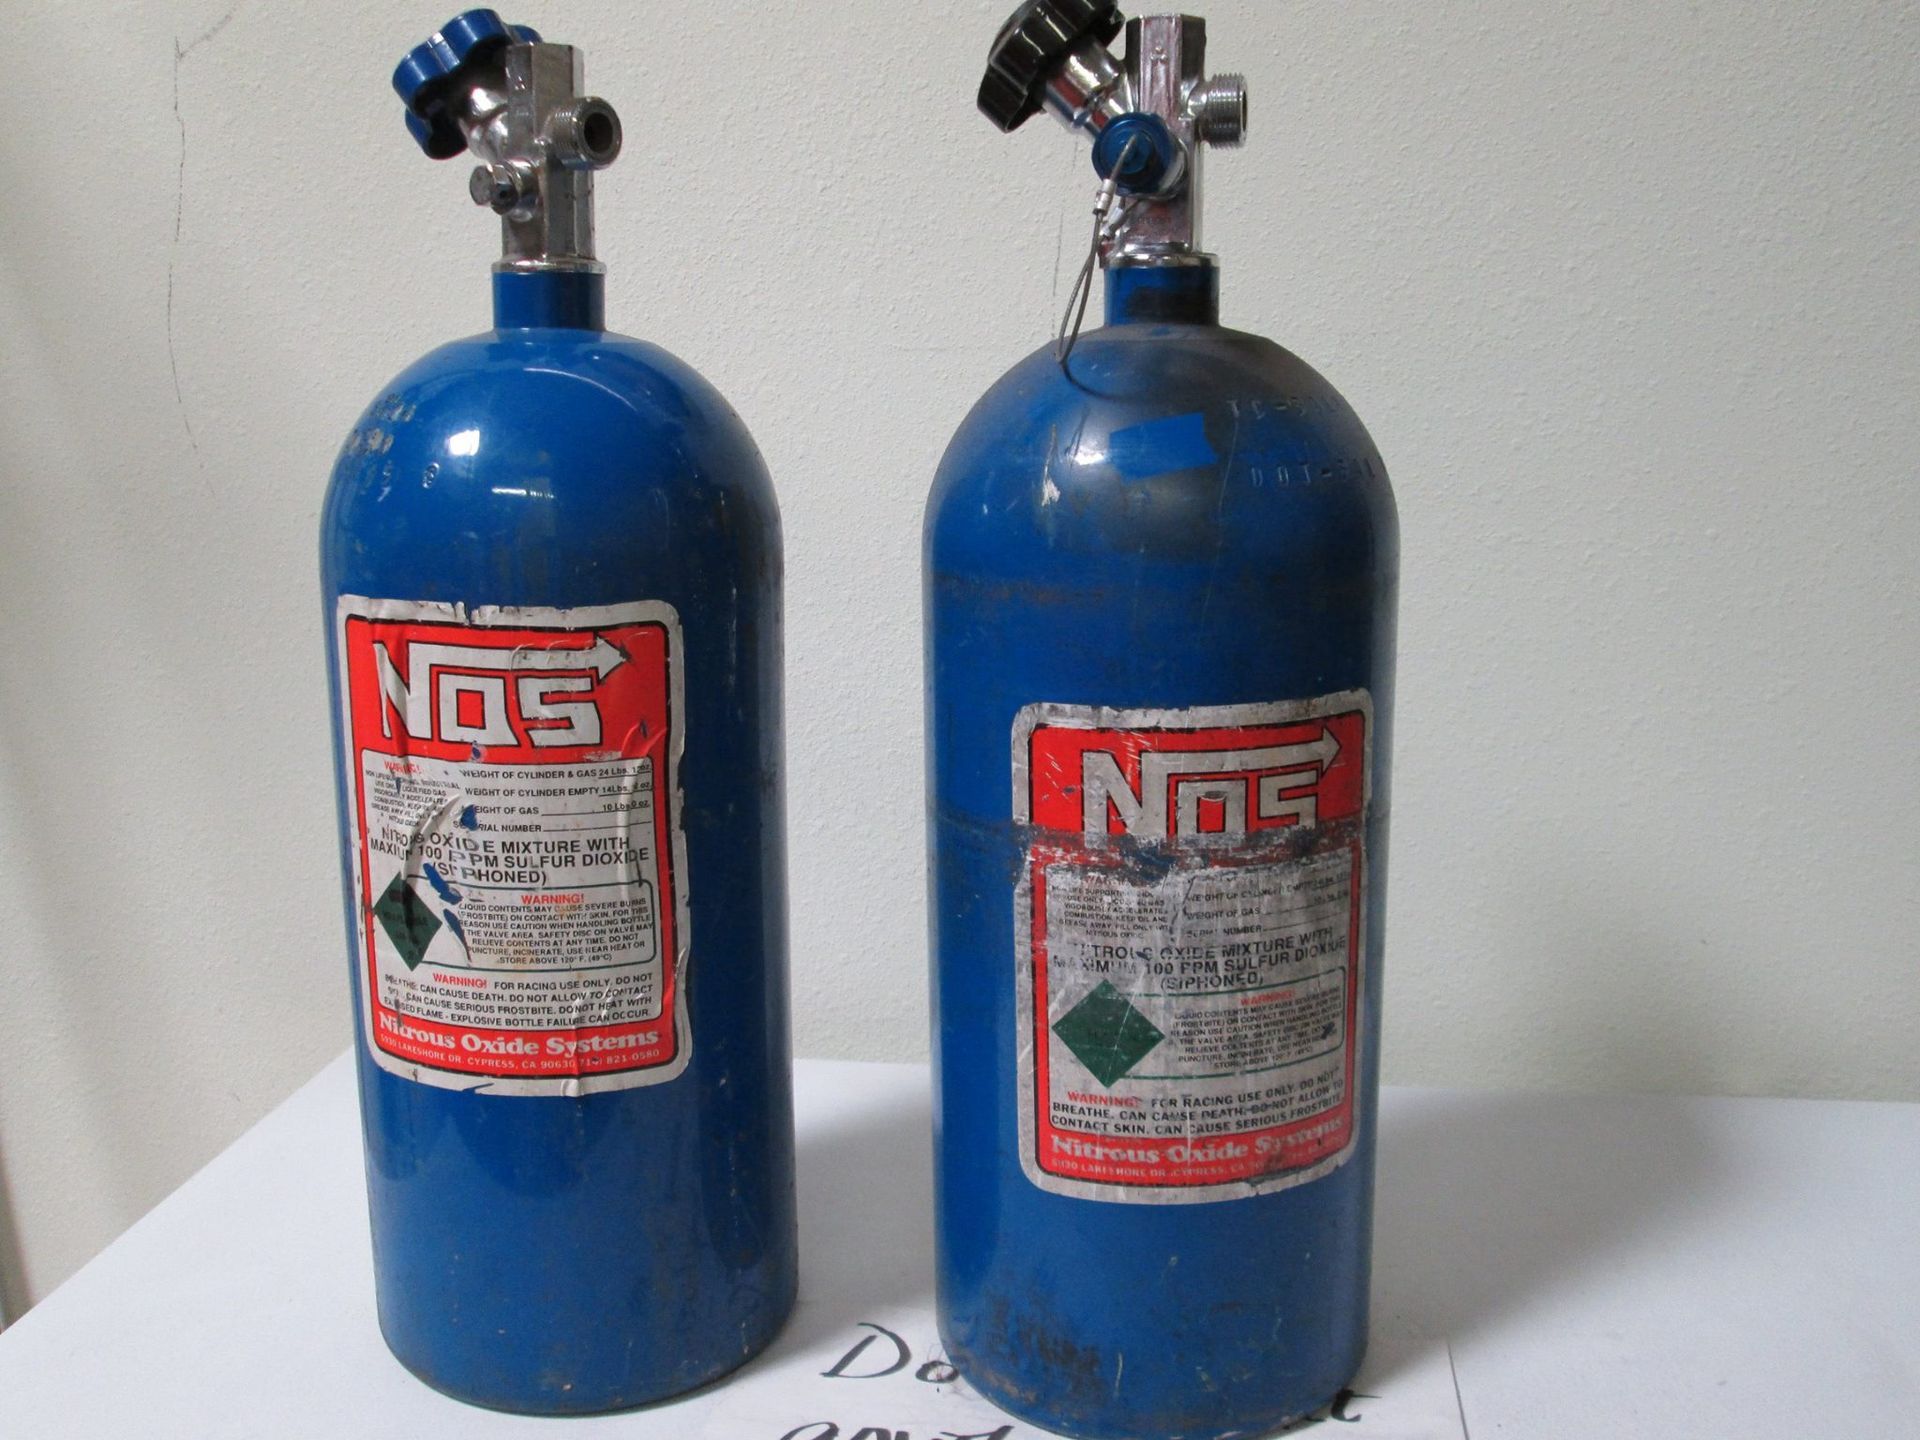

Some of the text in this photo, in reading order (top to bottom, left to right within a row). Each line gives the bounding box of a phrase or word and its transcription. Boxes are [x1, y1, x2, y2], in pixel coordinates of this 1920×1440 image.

[373, 637, 606, 748] NOS
[460, 770, 500, 779] WEIGHT
[502, 771, 515, 779] OF
[517, 770, 565, 779] CYLINDER
[567, 770, 574, 778] &
[576, 769, 597, 778] GAS
[599, 768, 609, 776] 24
[465, 786, 600, 797] WEIGHT OF CYLINDER EMPTY
[1083, 744, 1322, 850] NOS
[504, 803, 613, 815] OF GAS 10
[453, 821, 542, 833] SRIAL NUMBER
[430, 832, 496, 853] OXIDE
[502, 839, 581, 854] MIXTURE
[587, 837, 630, 850] WITH
[419, 846, 443, 860] 100
[504, 852, 576, 869] SULFUR
[582, 847, 650, 867] DIOXIDE
[459, 903, 487, 912] LIQUID
[488, 905, 532, 913] CONTENTS
[534, 905, 552, 913] MAY
[585, 901, 618, 911] SEVERE
[521, 893, 585, 905] WARNING!
[524, 913, 564, 921] CONTACT
[566, 912, 588, 920] WITH
[612, 909, 629, 917] FOR
[631, 906, 649, 915] THIS
[1241, 907, 1262, 917] GAS
[467, 922, 653, 939] THE VALVE SAFETY DISC ON VALVE MAY
[492, 922, 510, 930] USE
[510, 922, 548, 930] CAUTION
[549, 921, 575, 930] WHEN
[576, 919, 619, 929] HANDLING
[620, 914, 651, 925] BOTTLE
[1222, 924, 1263, 936] NUMBER
[472, 933, 639, 947] RELIEVE CONTENTS AT ANY DO NOT
[566, 940, 646, 954] USE NEAR HEAT OR
[1221, 936, 1295, 958] MIXTURE
[1299, 926, 1333, 946] WITH
[499, 956, 559, 965] STORE ABOVE
[1145, 962, 1174, 975] 100
[1224, 951, 1290, 972] SULFUR
[432, 972, 488, 989] WARNING!
[494, 981, 515, 990] FOR
[517, 982, 557, 991] RACING
[559, 980, 580, 990] USE
[615, 976, 631, 986] DO
[633, 972, 653, 983] NOT
[420, 983, 438, 994] CAN
[439, 987, 470, 1000] CAUSE
[509, 994, 524, 1003] DO
[527, 994, 548, 1003] NOT
[550, 991, 587, 1002] ALLOW
[589, 991, 603, 1000] TO
[605, 984, 653, 999] CONTACT
[405, 992, 422, 1005] CAN
[423, 995, 453, 1008] CAUSE
[454, 1000, 496, 1014] SERIOUS
[558, 1005, 574, 1014] DO
[575, 1002, 598, 1013] NOT
[598, 999, 623, 1011] HEAT
[626, 996, 652, 1007] WITH
[416, 1007, 444, 1020] FLAME
[450, 1013, 501, 1026] EXPLOSIVE
[505, 1017, 544, 1028] BOTTLE
[546, 1014, 587, 1027] FAILURE
[588, 1012, 610, 1024] CAN
[378, 1010, 660, 1059] Nitrous Oxide Systems
[398, 1041, 447, 1060] LAKESHORE
[521, 1059, 537, 1069] CA
[540, 1058, 576, 1070] 90630
[1151, 1097, 1178, 1108] FOR
[1182, 1094, 1234, 1108] RACING
[1237, 1090, 1262, 1104] USE
[1299, 1078, 1314, 1089] DO
[1119, 1110, 1147, 1121] CAN
[1151, 1111, 1196, 1121] CAUSE
[1270, 1097, 1295, 1110] NOT
[1299, 1086, 1331, 1102] ALLOW
[1051, 1114, 1109, 1131] CONTACT
[1155, 1124, 1183, 1135] CAN
[1189, 1120, 1231, 1134] CAUSE
[1235, 1111, 1287, 1130] SERIOUS
[1050, 1133, 1161, 1164] Nitrous
[1167, 1140, 1249, 1163] Oxide
